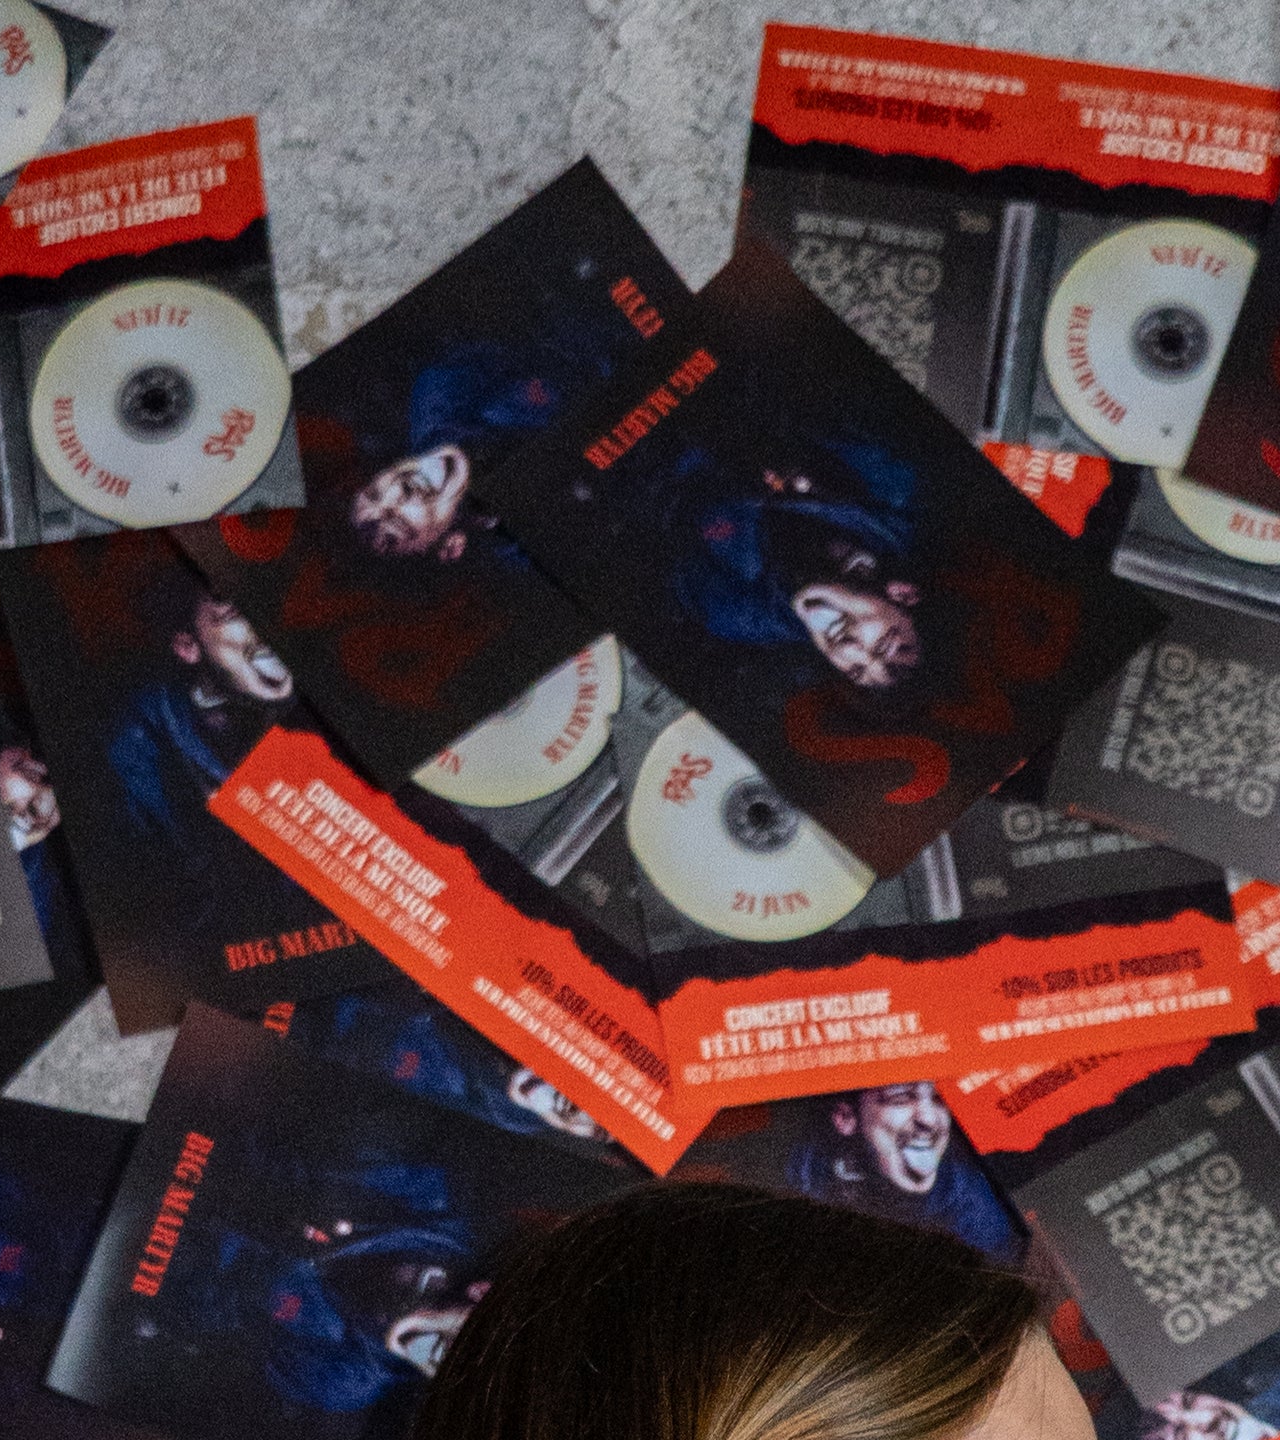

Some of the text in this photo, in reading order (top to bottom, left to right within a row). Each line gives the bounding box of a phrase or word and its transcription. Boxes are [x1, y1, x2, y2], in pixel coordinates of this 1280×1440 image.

[112, 304, 190, 331] 21 JUIN
[52, 396, 131, 498] BIG MARTYR
[201, 407, 257, 462] RAS
[130, 1130, 215, 1299] BIG MARTYR
